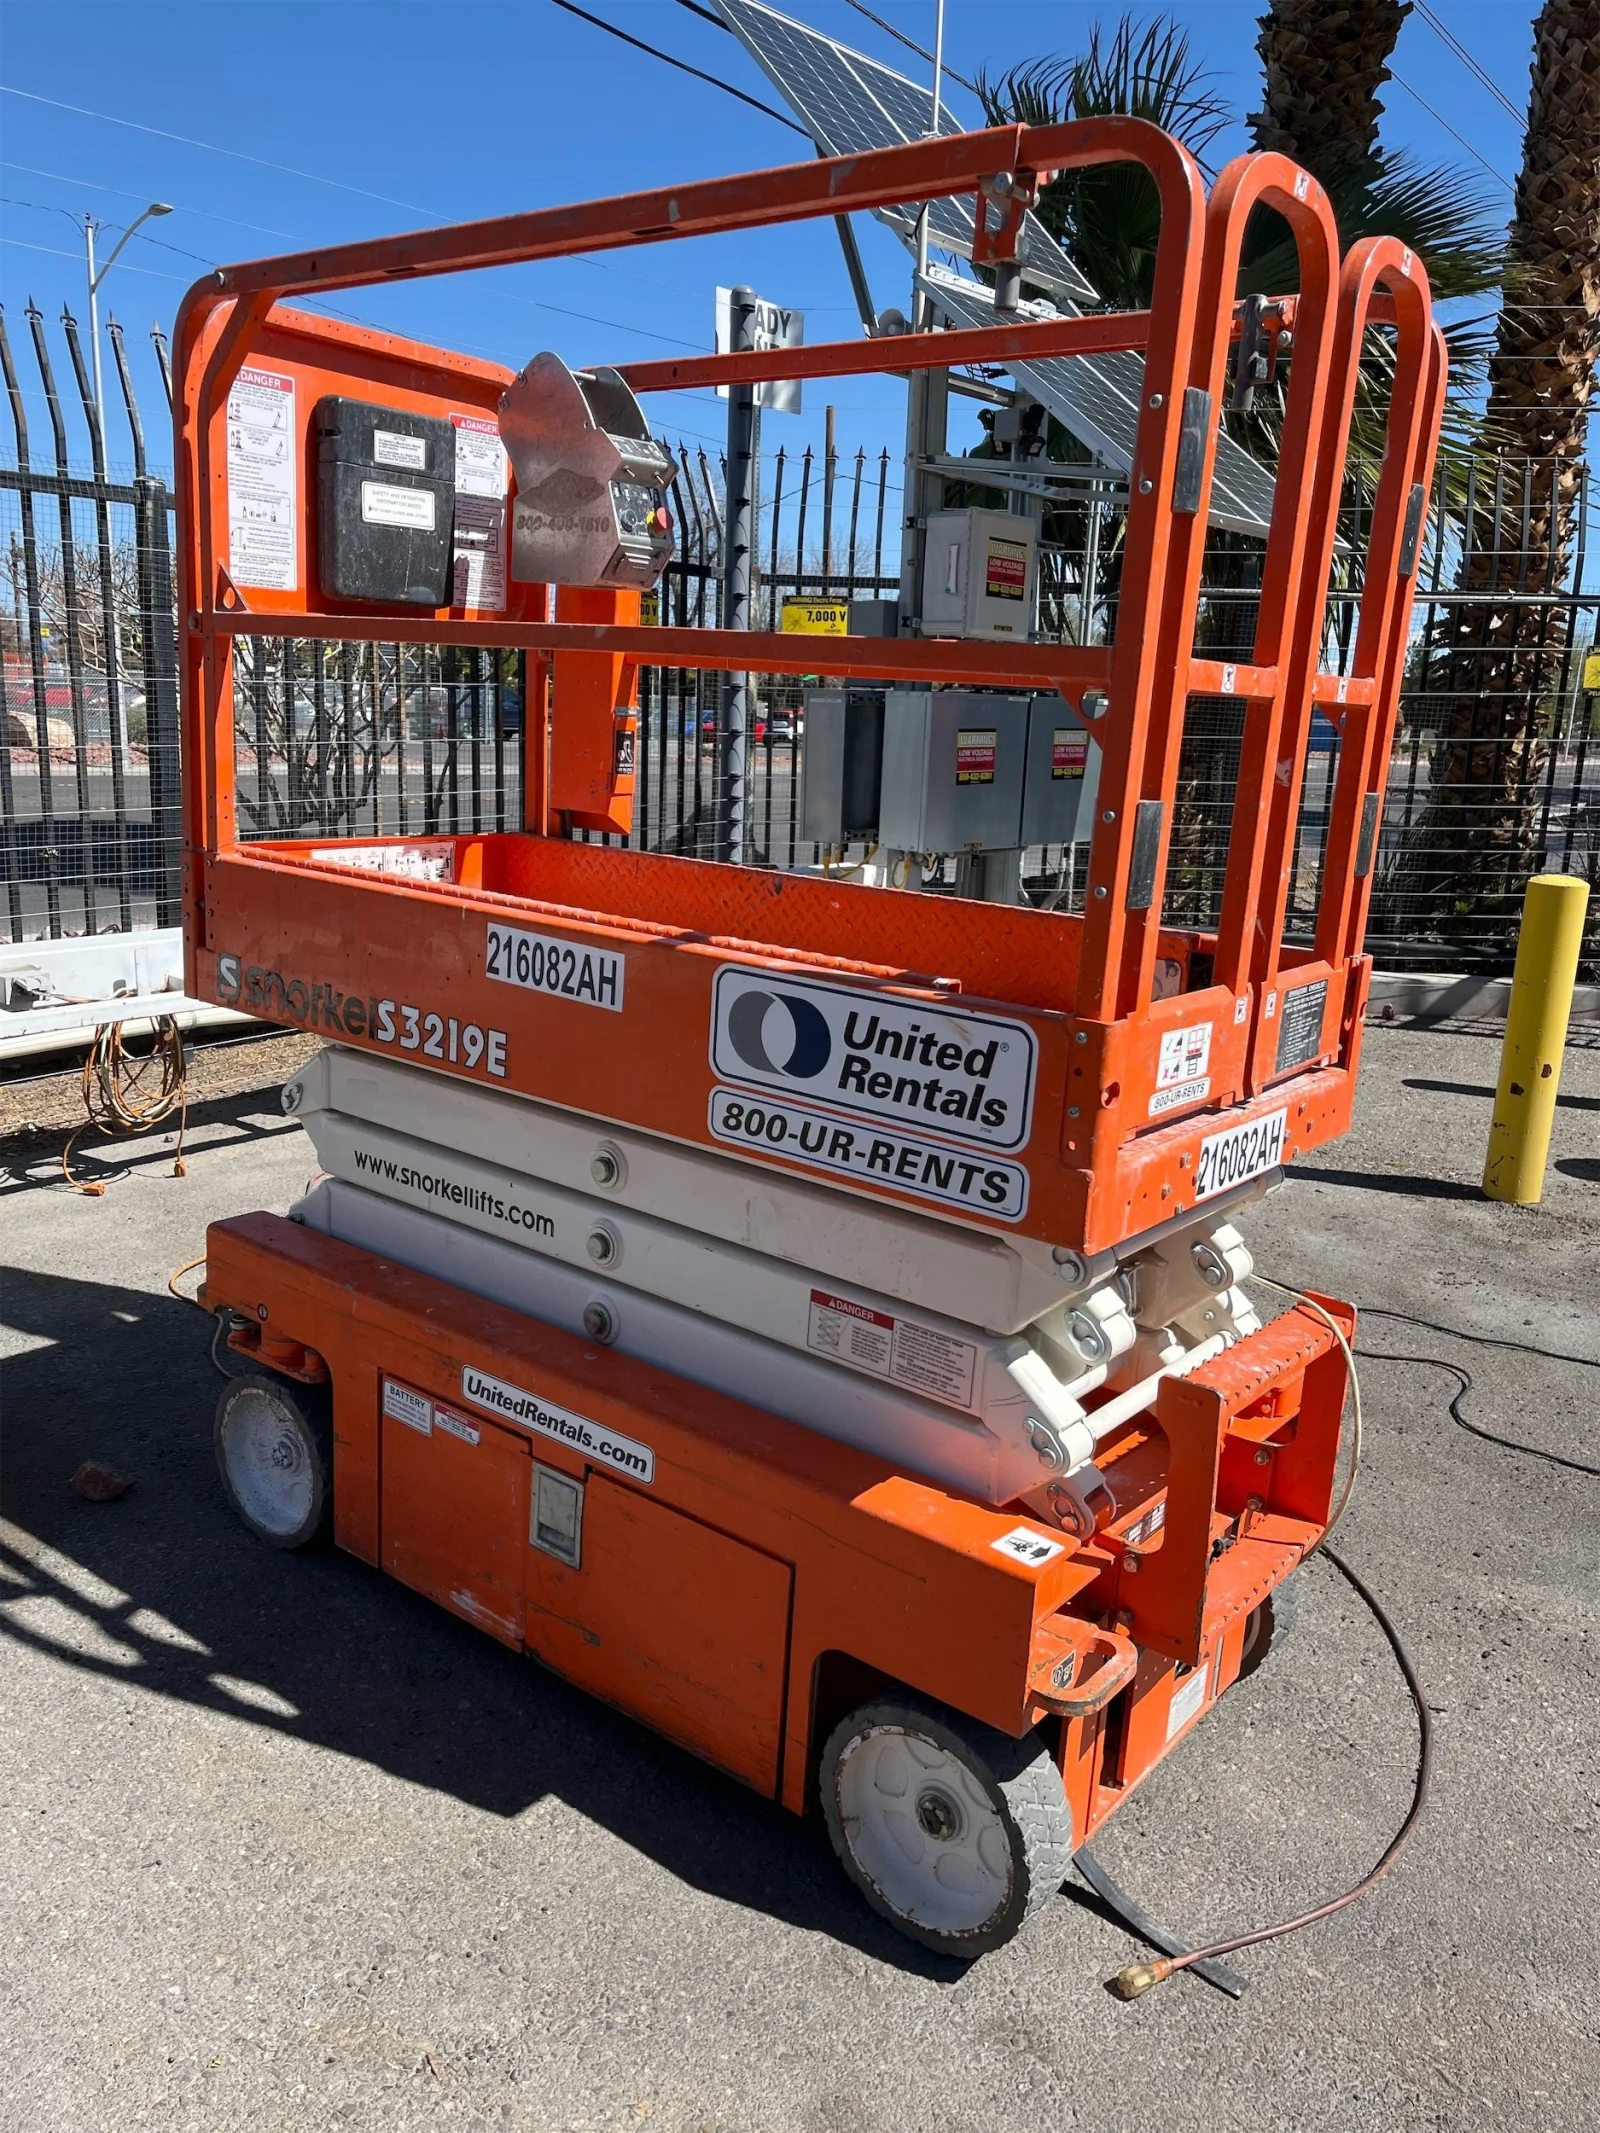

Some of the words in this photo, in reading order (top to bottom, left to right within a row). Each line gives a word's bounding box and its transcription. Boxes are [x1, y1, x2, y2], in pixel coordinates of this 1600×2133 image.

[755, 303, 792, 339] ADY
[240, 370, 281, 389] DANGER
[466, 420, 497, 434] DANGER
[1002, 560, 1024, 571] VOLTAGE
[807, 610, 836, 623] 7,000
[840, 611, 846, 622] V
[958, 749, 970, 757] LOW
[971, 748, 993, 756] VOLTAGE
[486, 931, 617, 1006] 216082AH
[245, 965, 375, 1041] snorkel
[376, 999, 508, 1078] S3219E
[837, 1053, 1008, 1128] Rentals
[1154, 1082, 1206, 1109] 800-UR-RENTS
[721, 1102, 1011, 1204] 800-UR-RENTS
[1195, 1116, 1282, 1197] 216082AH
[354, 1150, 555, 1238] www.snorkellifts.com
[836, 1300, 874, 1322] DANGER
[389, 1385, 426, 1410] BATTERY
[467, 1375, 648, 1474] UnitedRentals.com
